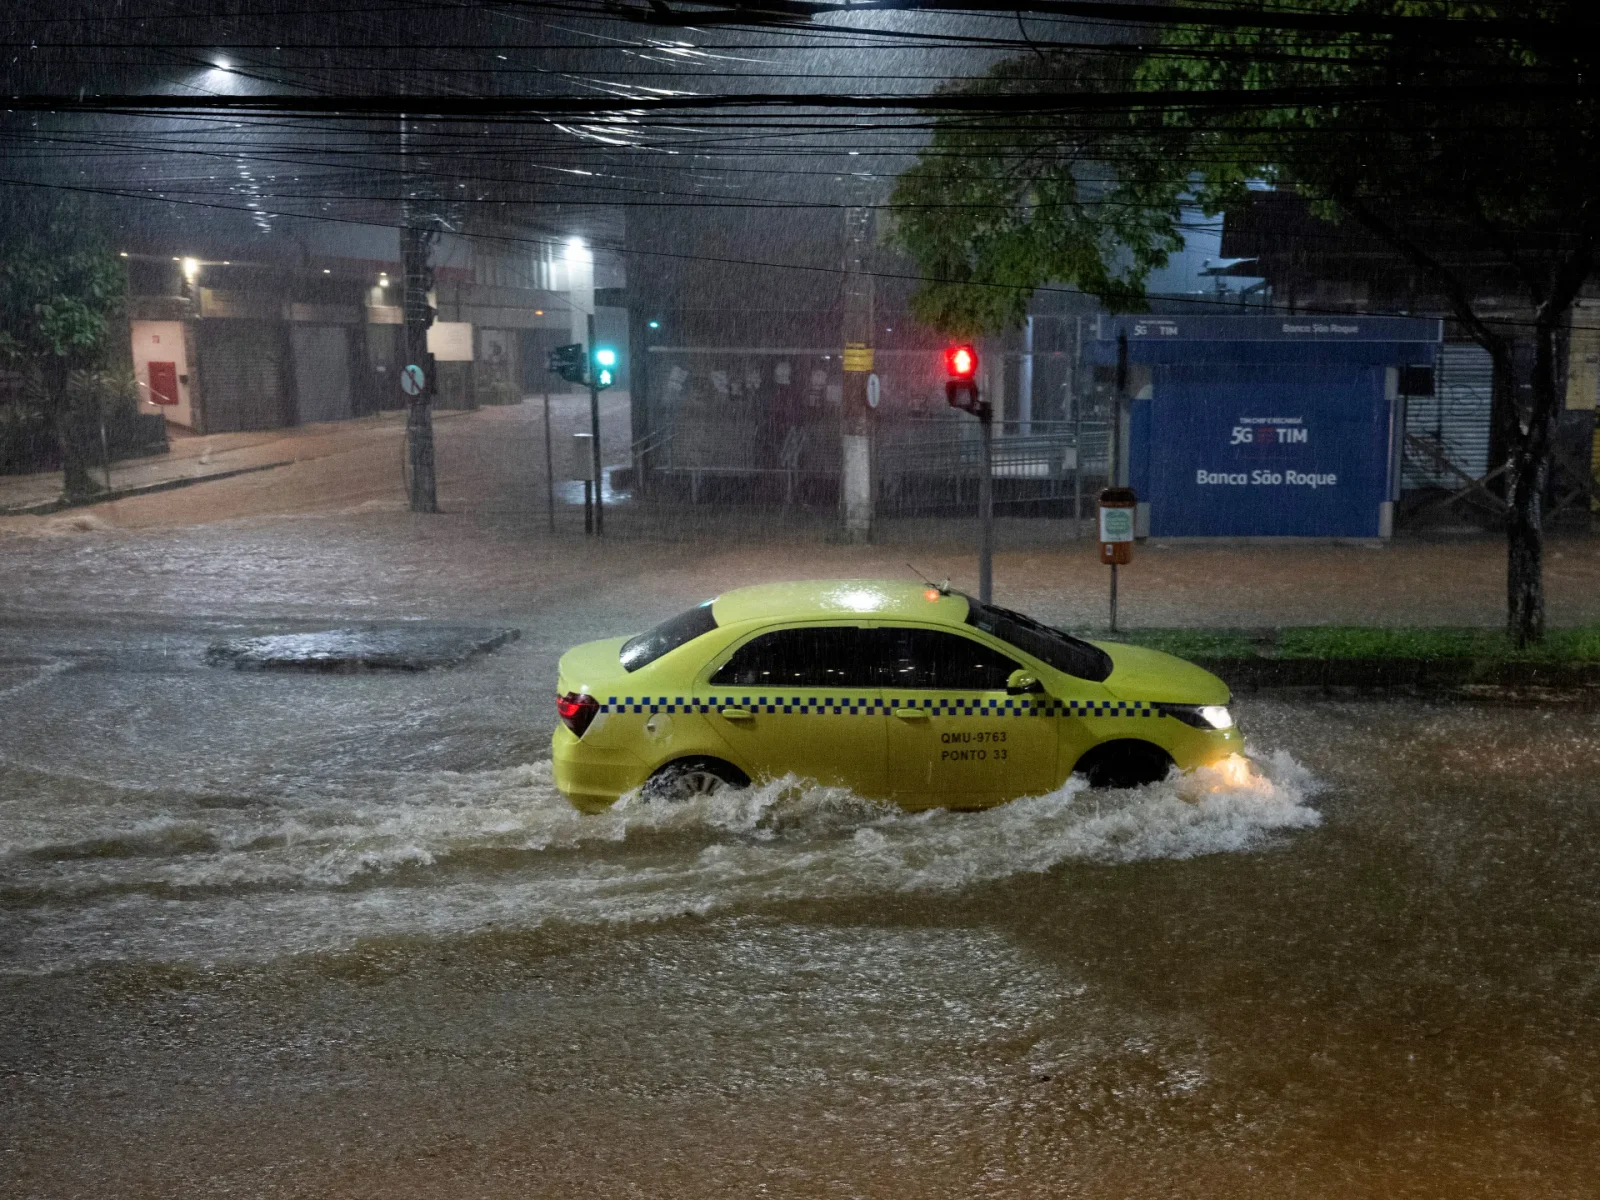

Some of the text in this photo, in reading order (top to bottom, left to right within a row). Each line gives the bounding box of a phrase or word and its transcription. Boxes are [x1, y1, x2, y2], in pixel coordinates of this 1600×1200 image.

[1160, 326, 1178, 336] TIM
[1230, 427, 1308, 445] 5G TIM
[1197, 470, 1337, 489] Banca São Roque
[941, 732, 1007, 744] QMU-9763
[941, 750, 1008, 761] PONTO 33
